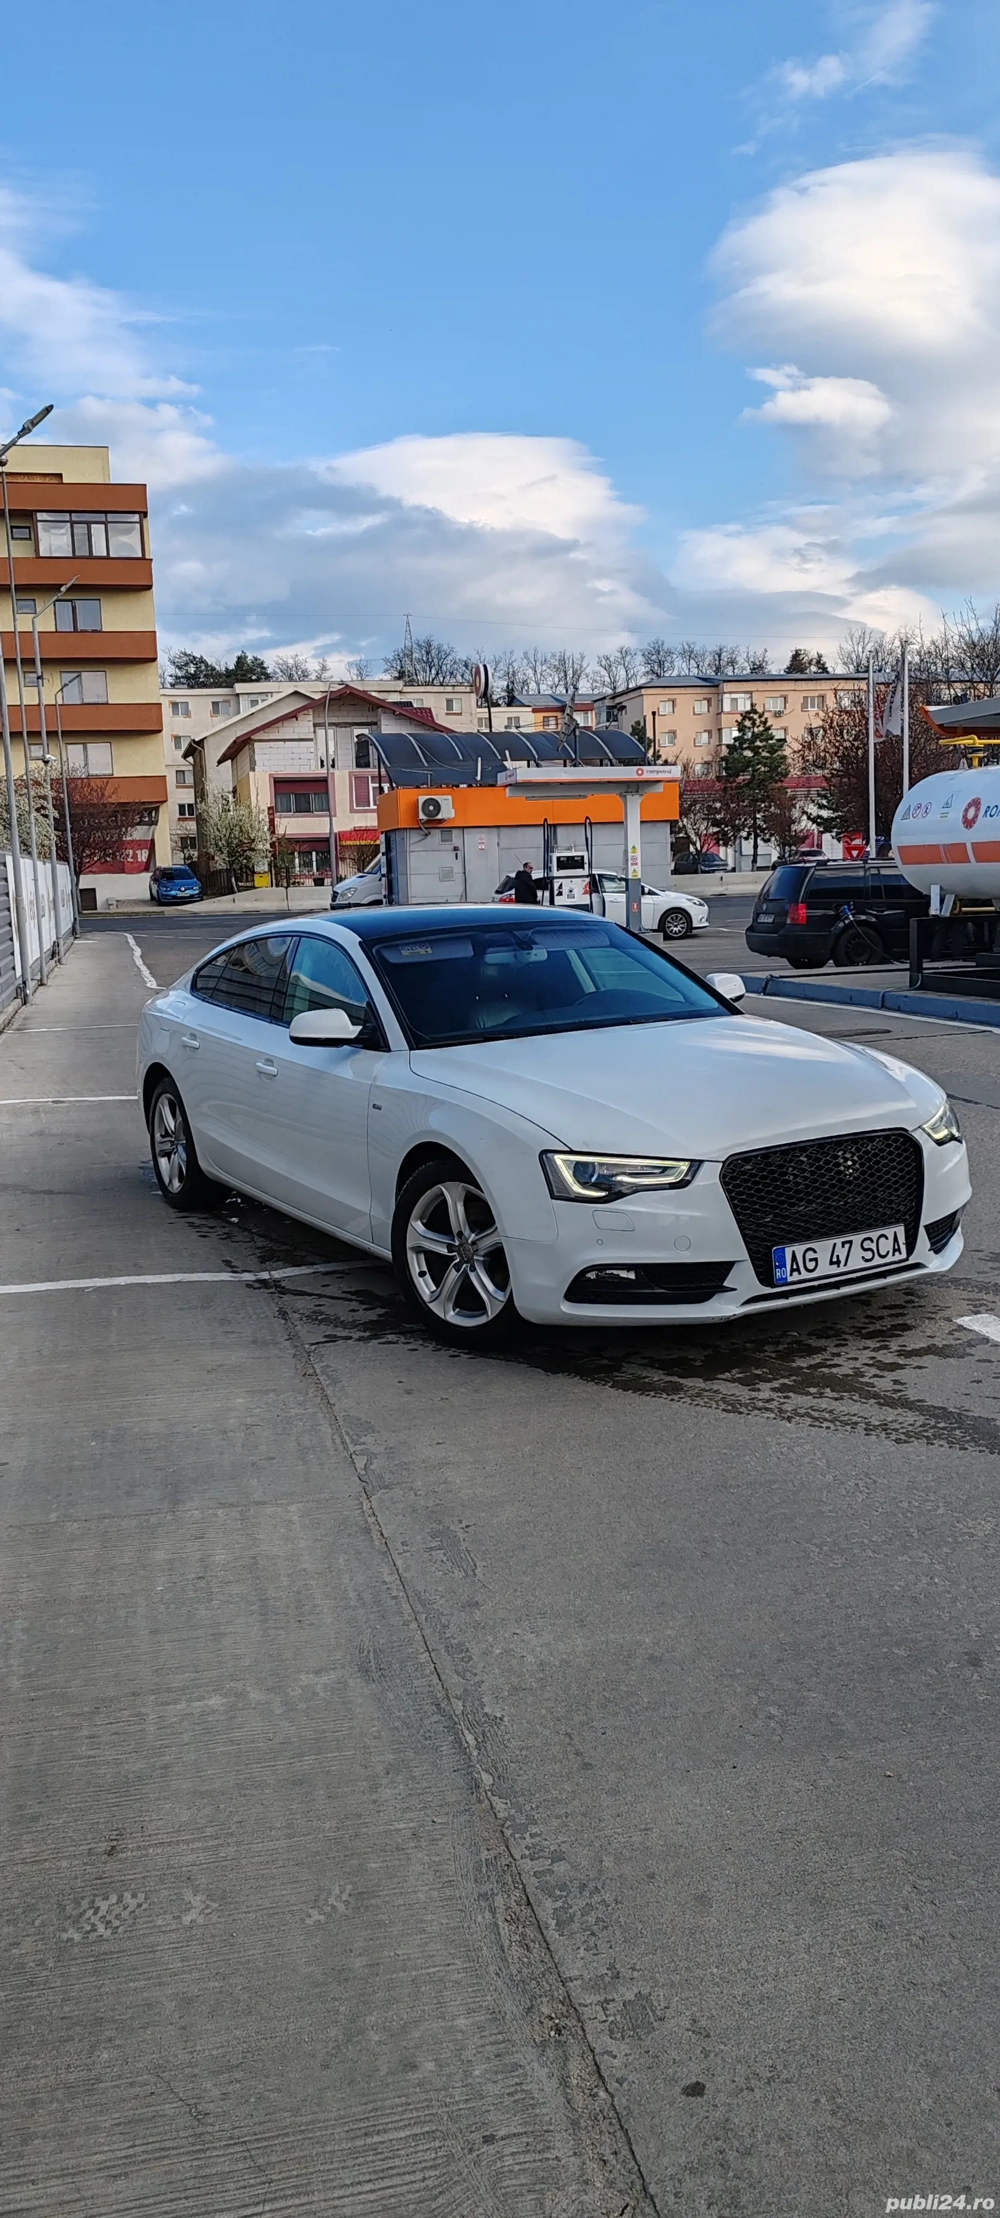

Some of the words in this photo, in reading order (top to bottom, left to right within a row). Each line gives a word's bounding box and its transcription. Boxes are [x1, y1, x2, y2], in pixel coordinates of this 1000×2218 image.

[646, 768, 672, 777] rompetrol
[789, 1247, 819, 1277] AG
[829, 1240, 853, 1268] 47
[860, 1231, 902, 1262] SCA
[776, 1267, 787, 1279] RO
